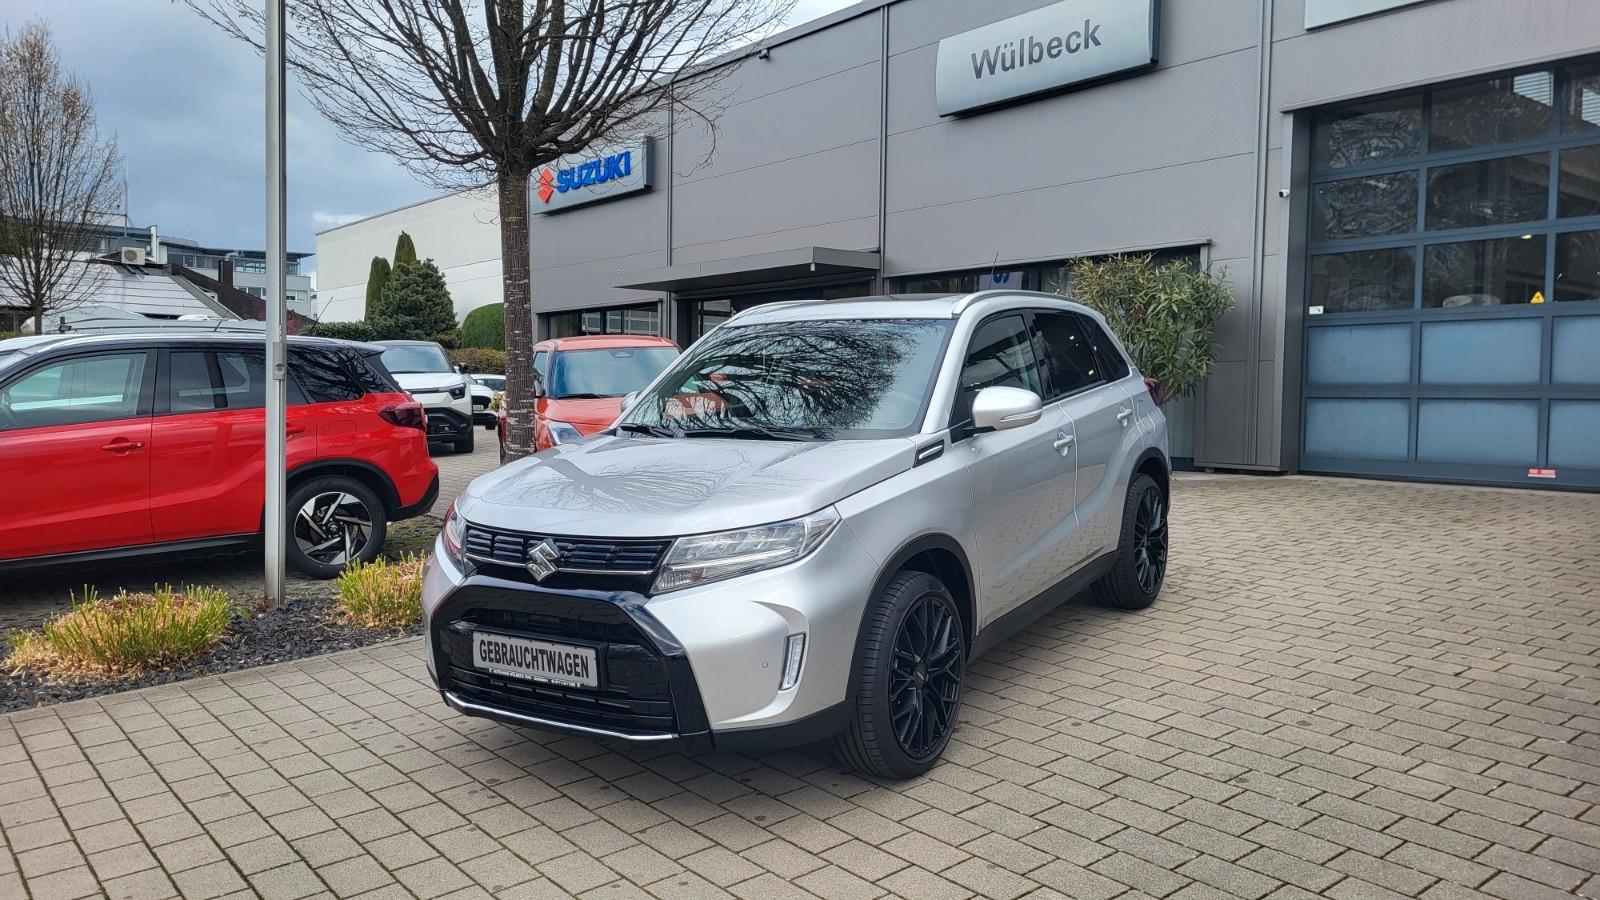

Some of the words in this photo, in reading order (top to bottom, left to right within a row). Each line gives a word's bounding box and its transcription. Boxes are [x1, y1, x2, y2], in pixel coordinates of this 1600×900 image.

[971, 19, 1102, 79] Wülbeck
[557, 150, 631, 193] SUZUKI
[479, 640, 589, 679] GEBRAUCHTWAGEN
